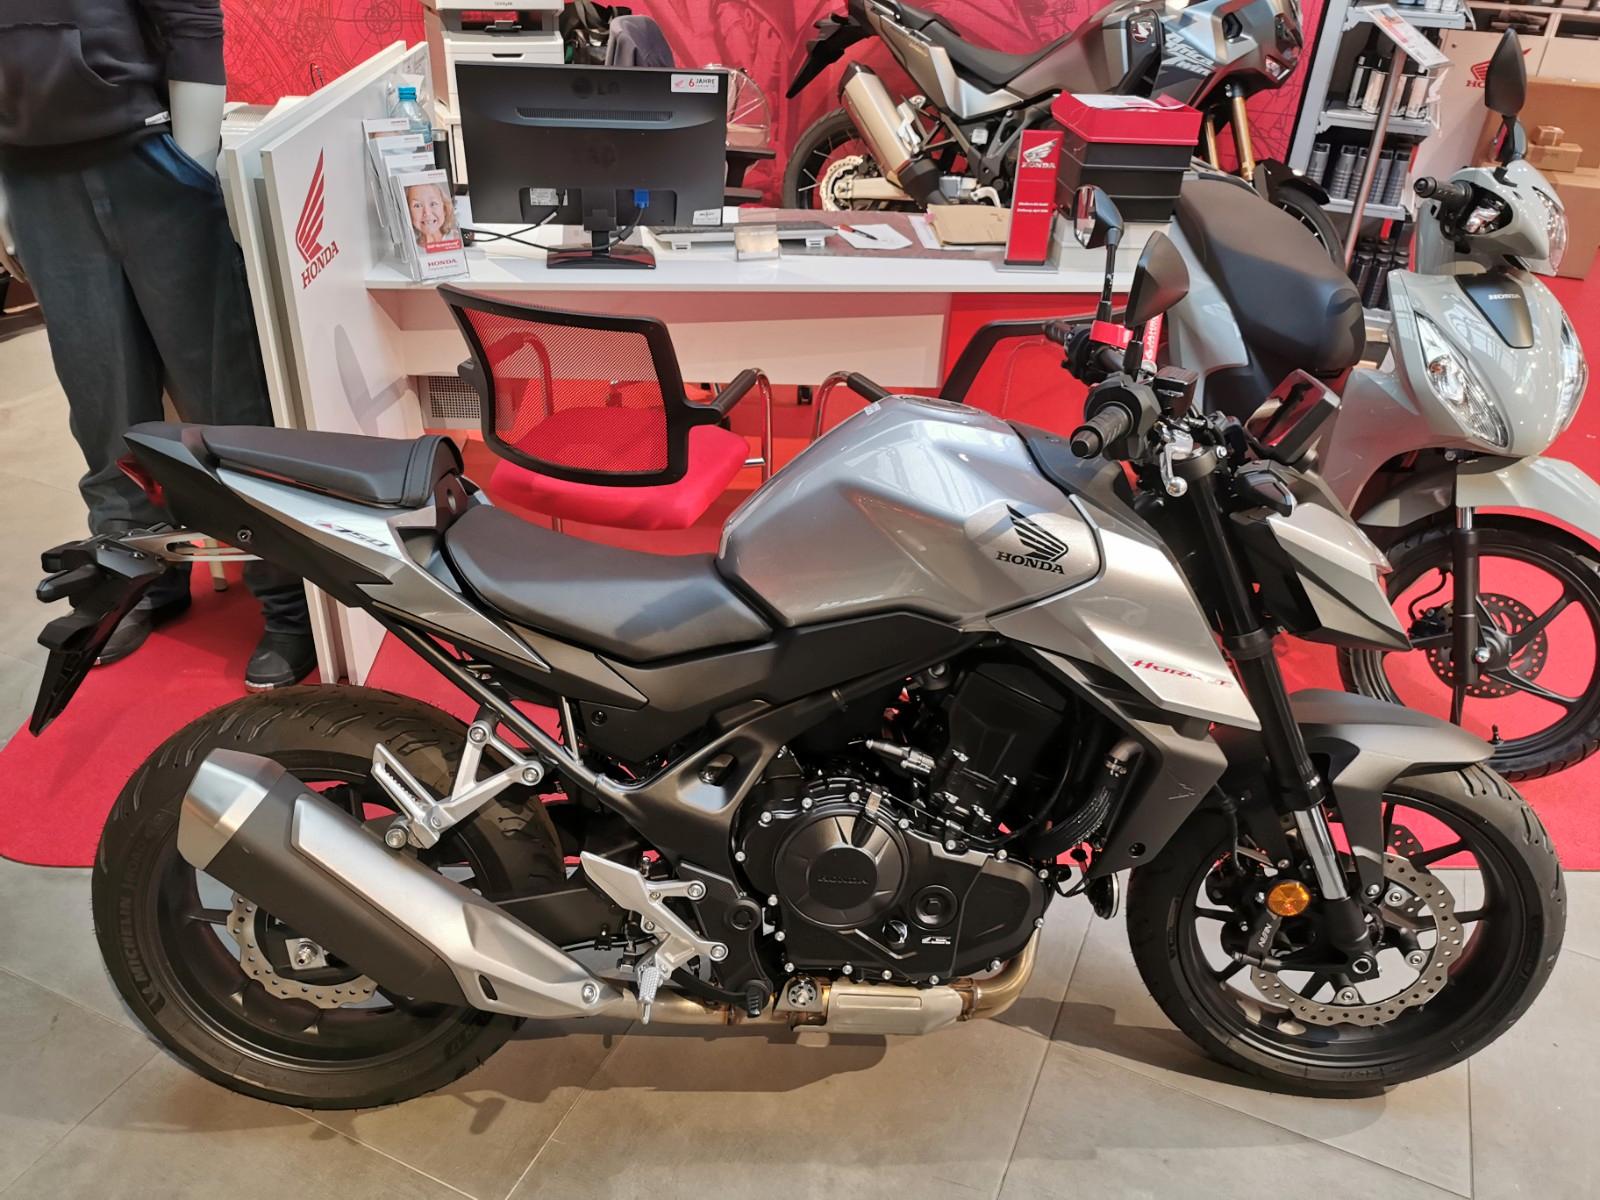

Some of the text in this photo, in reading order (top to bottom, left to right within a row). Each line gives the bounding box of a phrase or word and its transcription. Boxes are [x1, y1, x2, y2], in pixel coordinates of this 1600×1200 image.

[1161, 50, 1216, 77] Twin
[688, 78, 695, 88] 6
[1021, 161, 1056, 169] HONDA
[301, 240, 339, 289] HONDA
[427, 258, 458, 268] HONDA
[996, 551, 1065, 575] HONDA
[119, 896, 149, 983] MICHELIN
